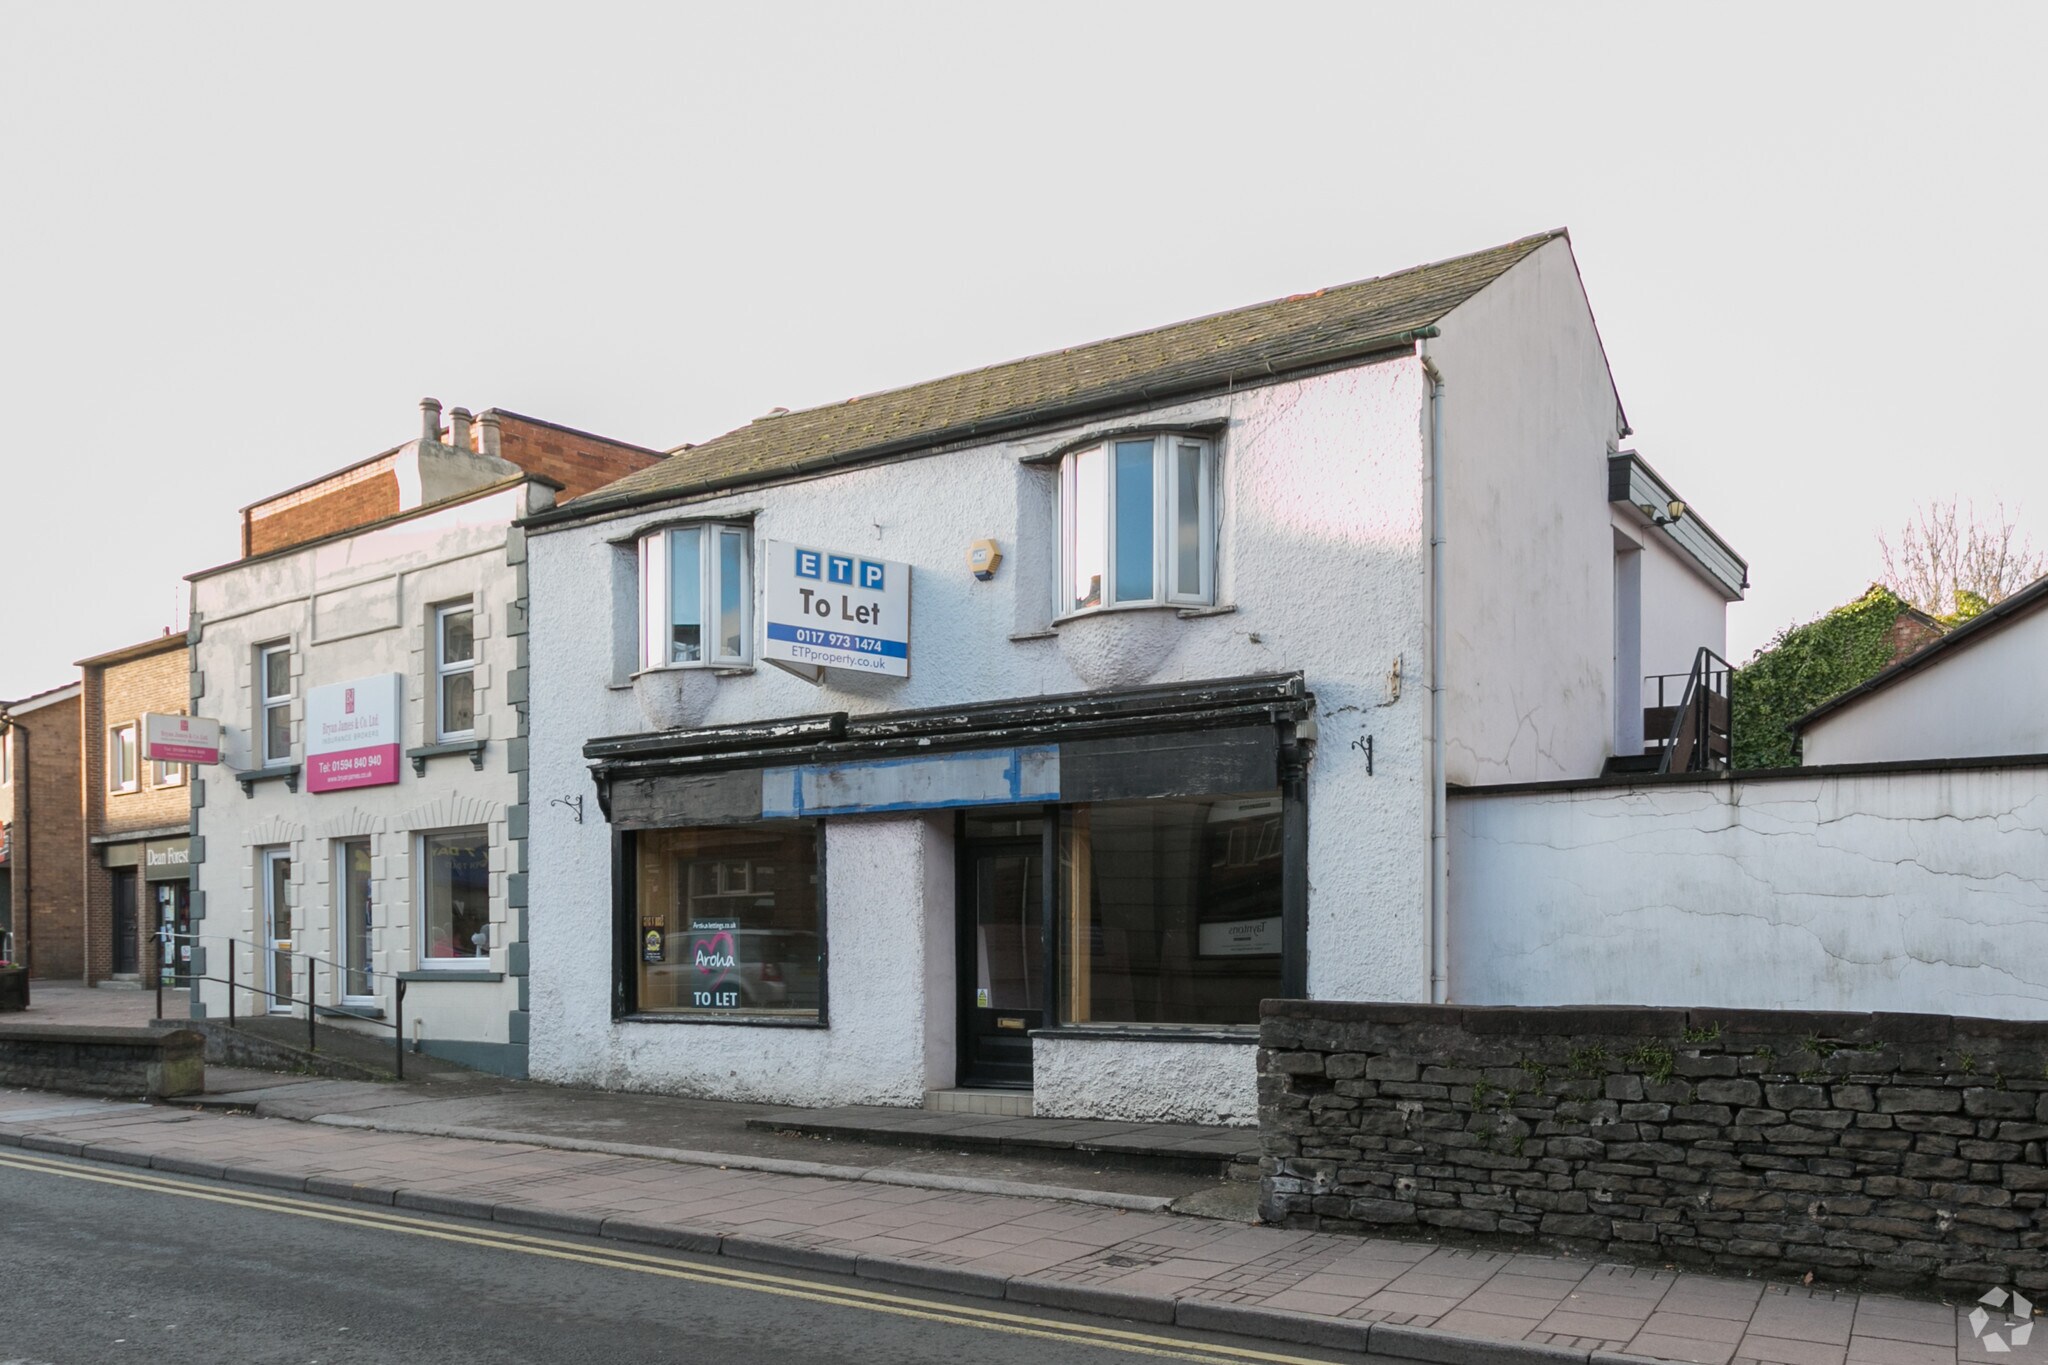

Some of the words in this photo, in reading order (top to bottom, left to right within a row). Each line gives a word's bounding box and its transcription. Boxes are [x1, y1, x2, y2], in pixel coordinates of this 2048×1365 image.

[799, 588, 831, 618] To
[842, 595, 880, 625] Let
[796, 629, 825, 645] 0117
[828, 635, 851, 648] 973
[855, 637, 882, 652] 1474
[791, 645, 886, 669] ETPproperty.co.uk
[322, 722, 337, 735] Bryan
[338, 720, 354, 732] James
[353, 729, 379, 740] BROKERS
[318, 762, 331, 773] Tel:
[332, 758, 353, 772] 01594
[354, 756, 367, 768] 840
[368, 754, 382, 766] 940
[147, 849, 166, 866] Dean
[167, 847, 189, 865] Forest
[695, 950, 735, 967] Aroha
[693, 992, 711, 1006] TO
[716, 992, 738, 1006] LET
